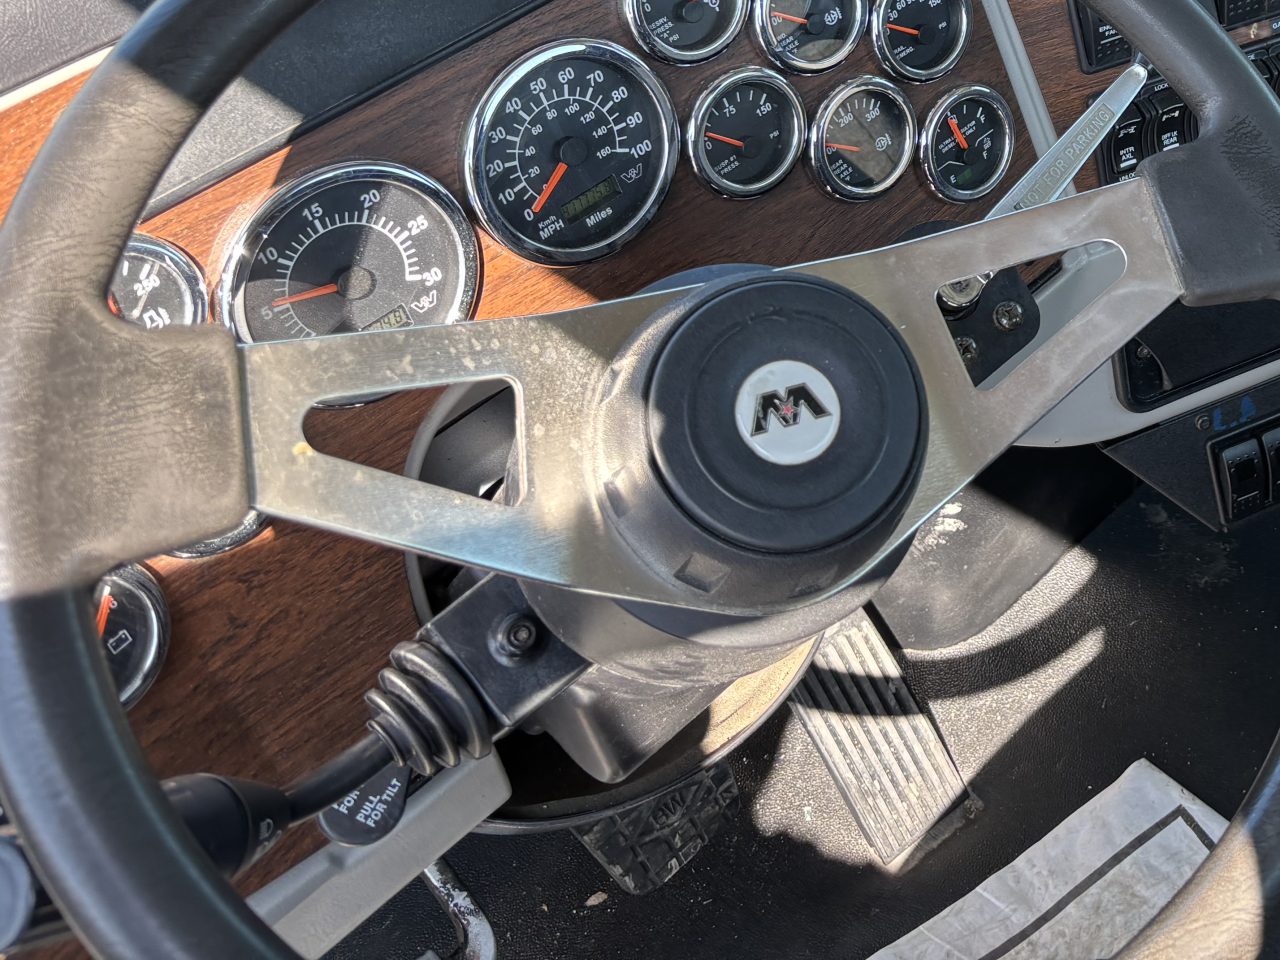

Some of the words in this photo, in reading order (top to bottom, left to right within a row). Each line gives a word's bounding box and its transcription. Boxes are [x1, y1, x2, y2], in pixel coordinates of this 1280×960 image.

[645, 3, 652, 12] 0
[896, 0, 906, 10] 60
[888, 10, 898, 21] 30
[938, 21, 947, 29] PSI
[668, 34, 680, 43] PSI
[785, 41, 800, 51] AXLE
[557, 67, 575, 84] 60
[586, 70, 604, 87] 70
[530, 77, 547, 94] 50
[1154, 82, 1169, 91] LOCK
[611, 86, 628, 103] 80
[505, 97, 522, 114] 40
[564, 102, 580, 117] 100
[723, 105, 736, 117] 75
[756, 103, 772, 116] 150
[546, 108, 558, 120] 80
[580, 110, 596, 125] 120
[626, 111, 643, 128] 90
[838, 113, 854, 128] 200
[865, 108, 880, 122] 300
[980, 114, 986, 123] F
[488, 126, 507, 144] 30
[531, 124, 543, 136] 60
[592, 125, 608, 139] 140
[769, 130, 780, 139] PSI
[705, 141, 713, 150] 0
[1163, 136, 1178, 145] REAR
[524, 145, 536, 158] 40
[596, 146, 612, 160] 160
[630, 139, 652, 159] 100
[1043, 159, 1069, 185] FOR
[1065, 111, 1110, 160] PARKING
[1119, 146, 1135, 156] INTR
[486, 159, 504, 177] 20
[528, 166, 541, 177] 20
[840, 167, 853, 178] AXLE
[950, 174, 957, 183] E
[1119, 172, 1136, 181] UNLOC
[360, 189, 380, 208] 20
[498, 188, 515, 205] 10
[302, 202, 323, 222] 15
[523, 208, 534, 221] 0
[585, 206, 613, 228] Miles
[407, 214, 429, 235] 25
[538, 215, 557, 229] Km/h
[538, 219, 565, 240] MPH
[257, 246, 278, 265] 10
[422, 266, 442, 286] 30
[133, 274, 160, 296] 250
[261, 307, 273, 320] 5
[356, 795, 380, 823] PULL
[366, 802, 387, 828] FOR
[381, 778, 402, 802] TILT
